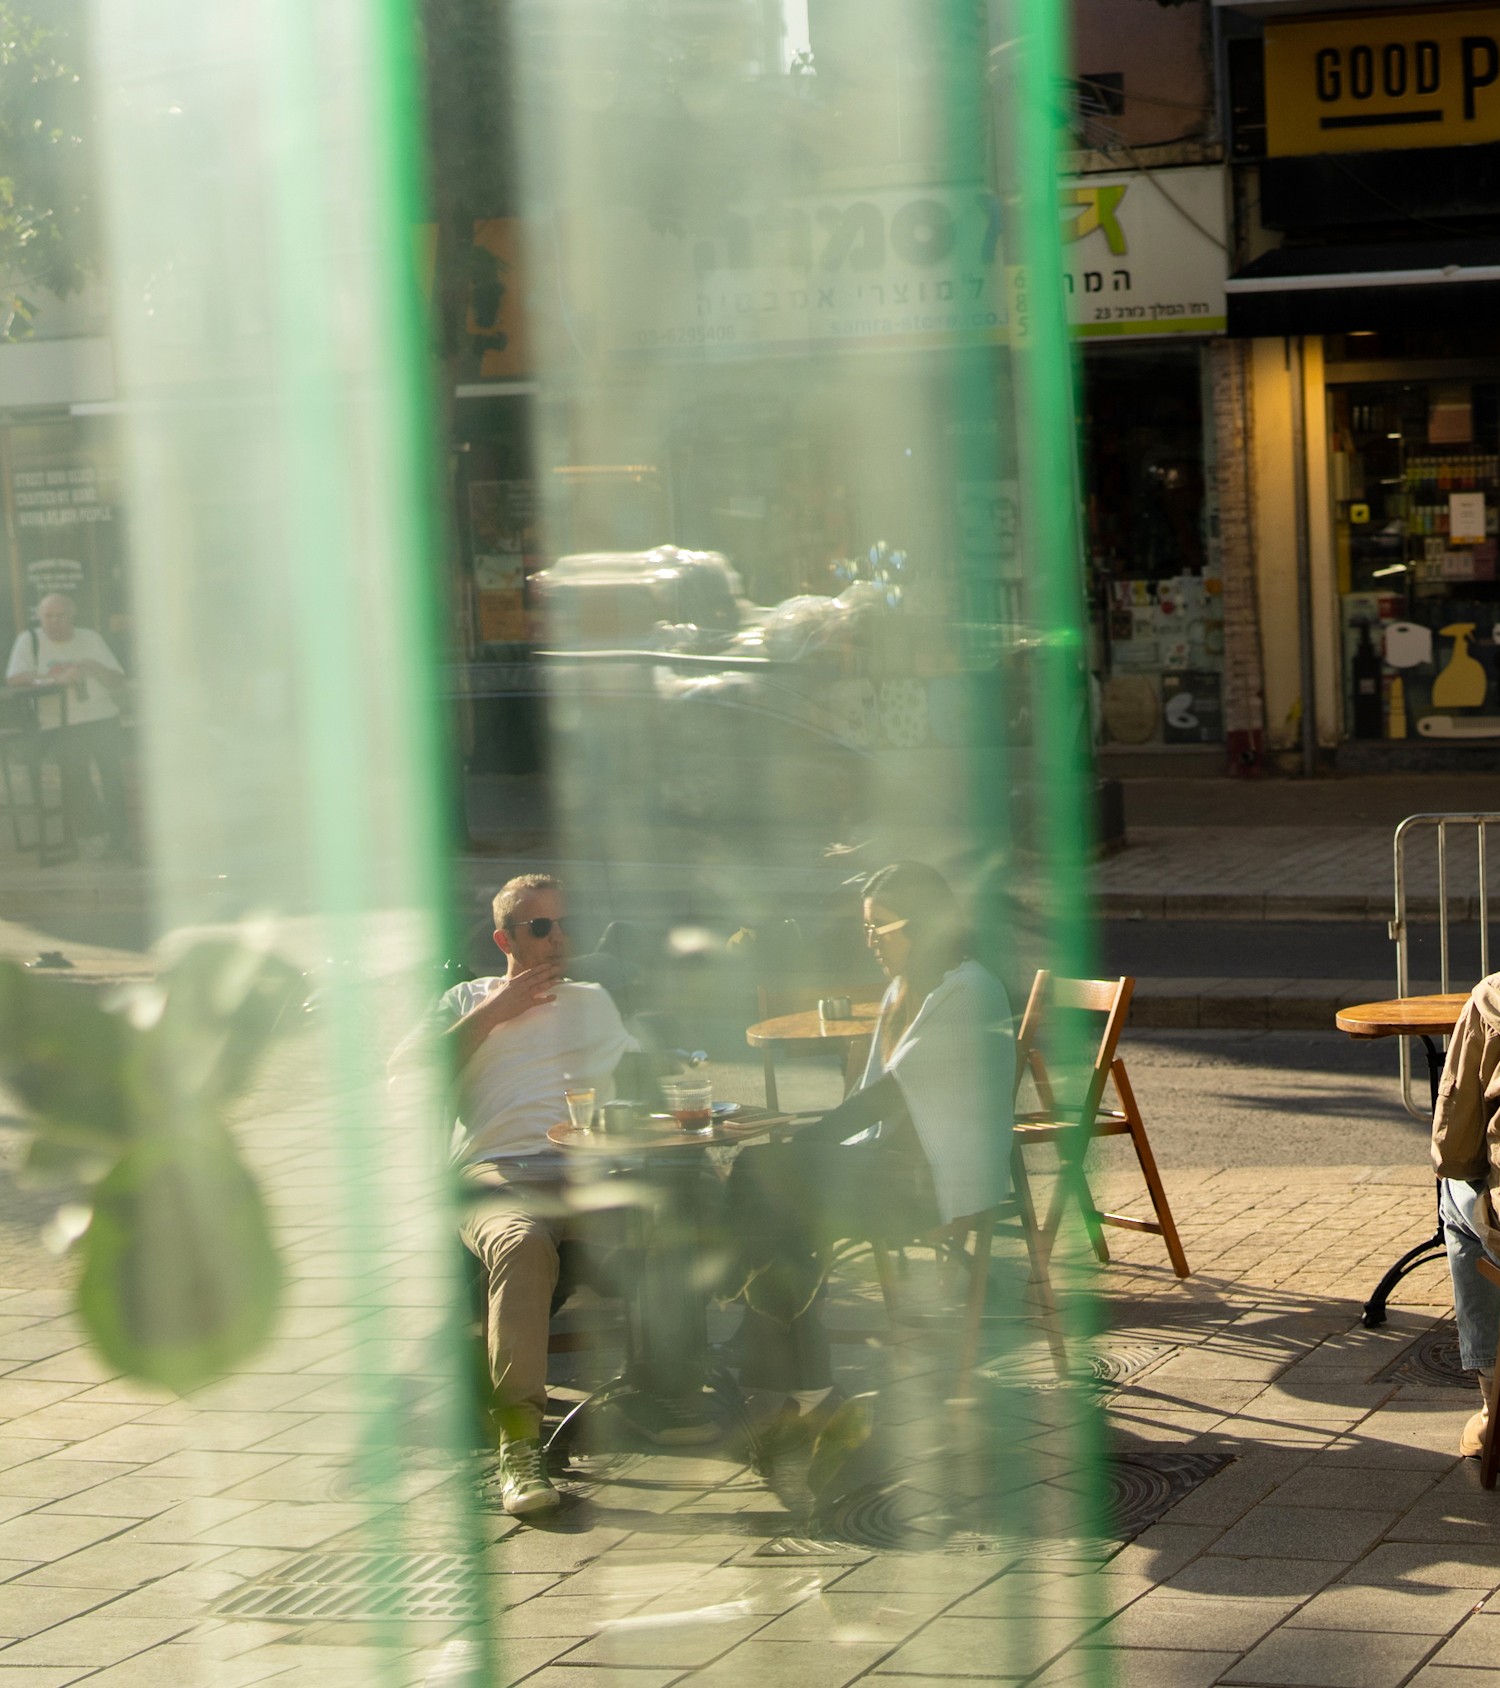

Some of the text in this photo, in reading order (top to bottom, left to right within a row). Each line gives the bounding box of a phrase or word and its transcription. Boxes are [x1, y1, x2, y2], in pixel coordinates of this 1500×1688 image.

[1316, 41, 1440, 102] GOOD
[1063, 268, 1132, 294] המר
[829, 308, 1010, 340] samra-store.co.i
